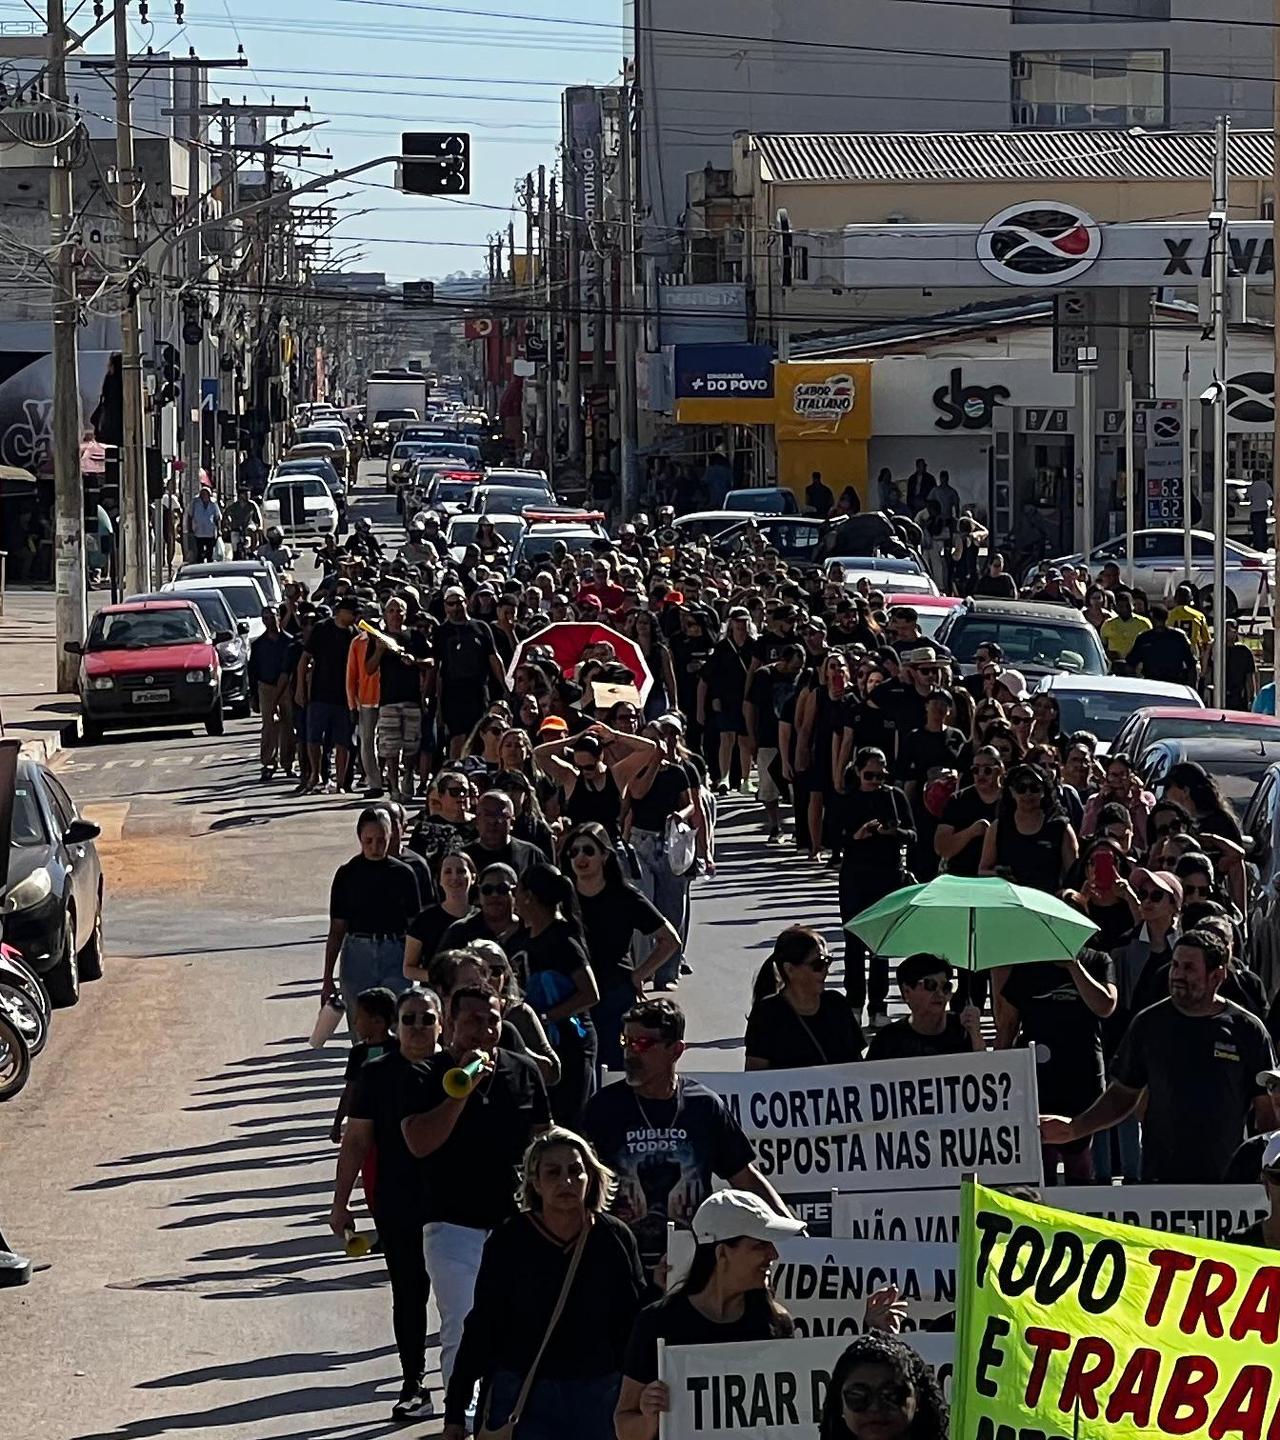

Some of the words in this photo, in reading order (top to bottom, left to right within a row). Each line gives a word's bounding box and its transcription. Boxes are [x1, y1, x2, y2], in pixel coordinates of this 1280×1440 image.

[707, 380, 727, 391] DO
[730, 379, 768, 391] POVO
[796, 386, 831, 397] SABOR
[797, 397, 850, 410] ITALIANO
[750, 1084, 863, 1129] CORTAR
[869, 1072, 1012, 1122] DIREITOS?
[626, 1126, 687, 1141] PÚBLICO
[875, 1130, 931, 1170] NAS
[940, 1125, 1021, 1168] RUAS!
[976, 1211, 1126, 1314] TODO
[976, 1316, 1010, 1398] E
[686, 1371, 800, 1431] TIRAR
